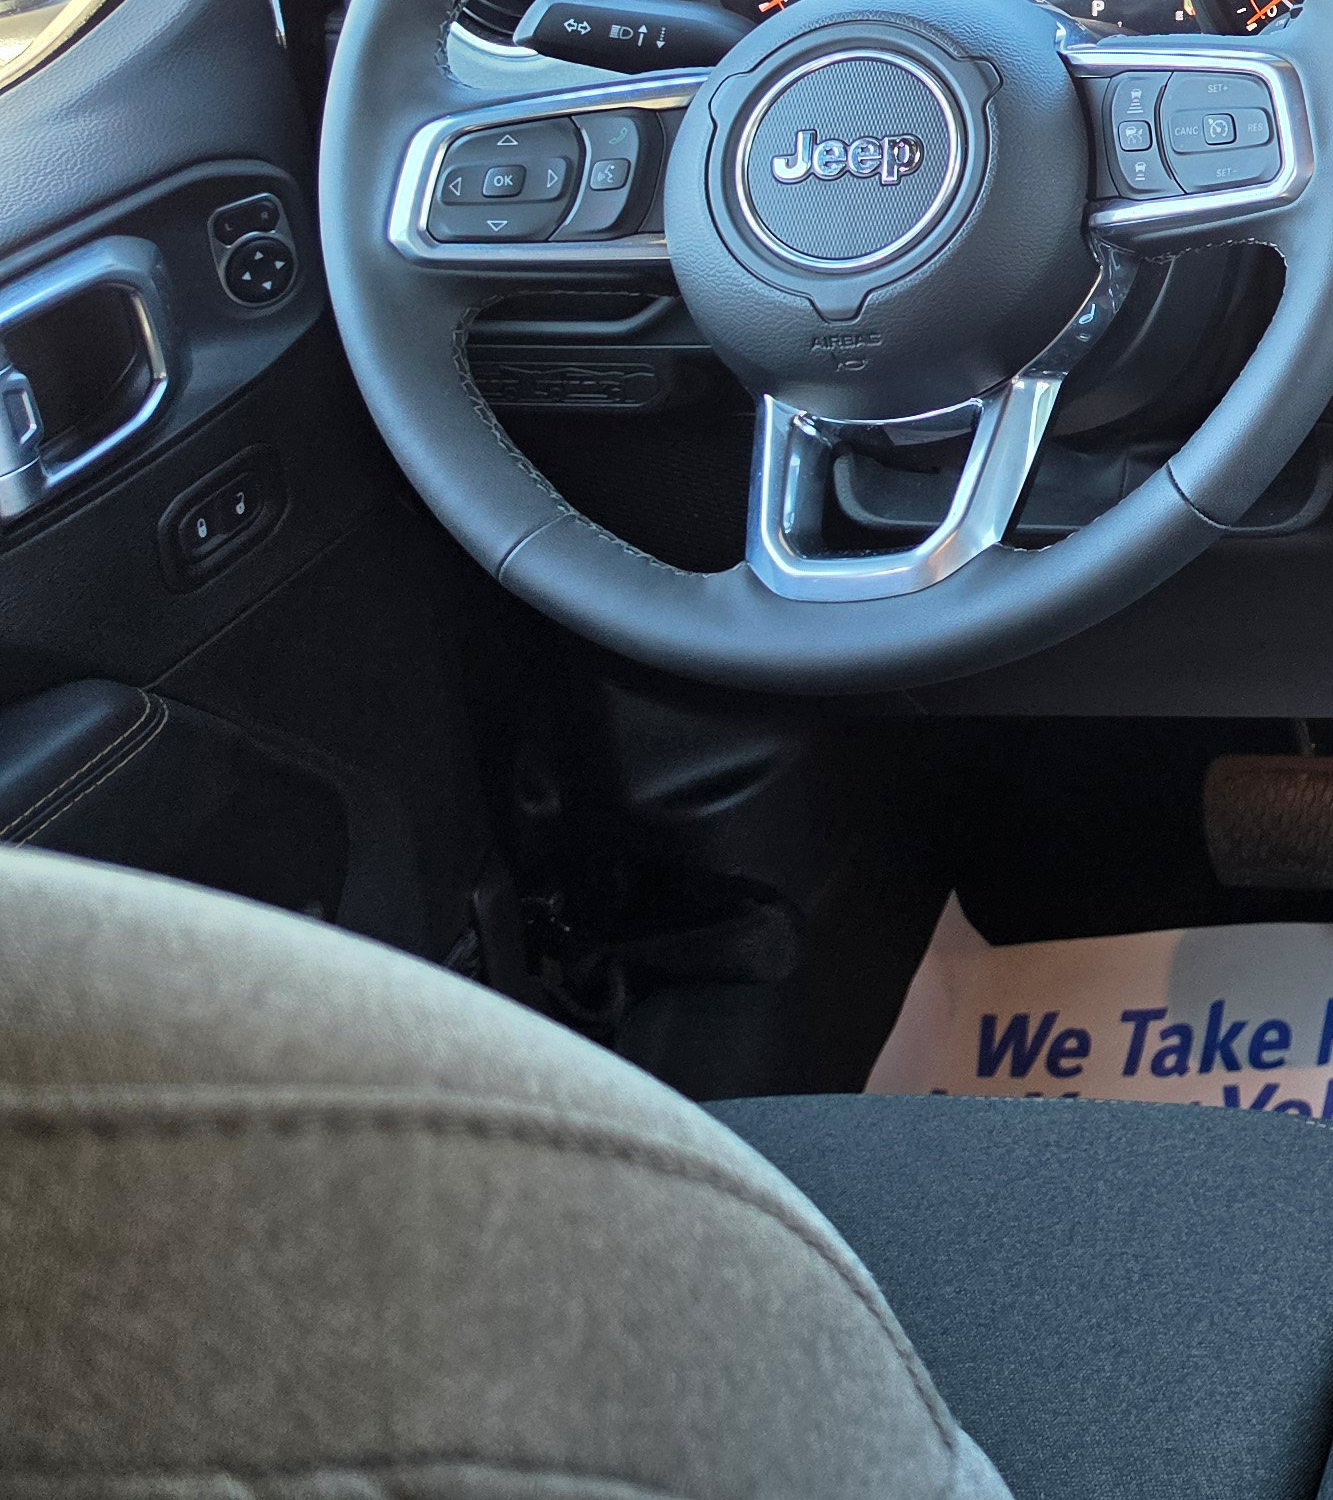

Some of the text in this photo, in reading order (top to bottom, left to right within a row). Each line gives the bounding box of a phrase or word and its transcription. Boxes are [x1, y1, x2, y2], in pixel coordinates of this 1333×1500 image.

[1092, 0, 1105, 17] P
[1174, 126, 1199, 136] CANC
[1247, 123, 1263, 132] RES
[771, 129, 924, 185] Jeep
[494, 174, 513, 187] OK
[975, 1009, 1092, 1080] We
[1119, 999, 1292, 1078] Take
